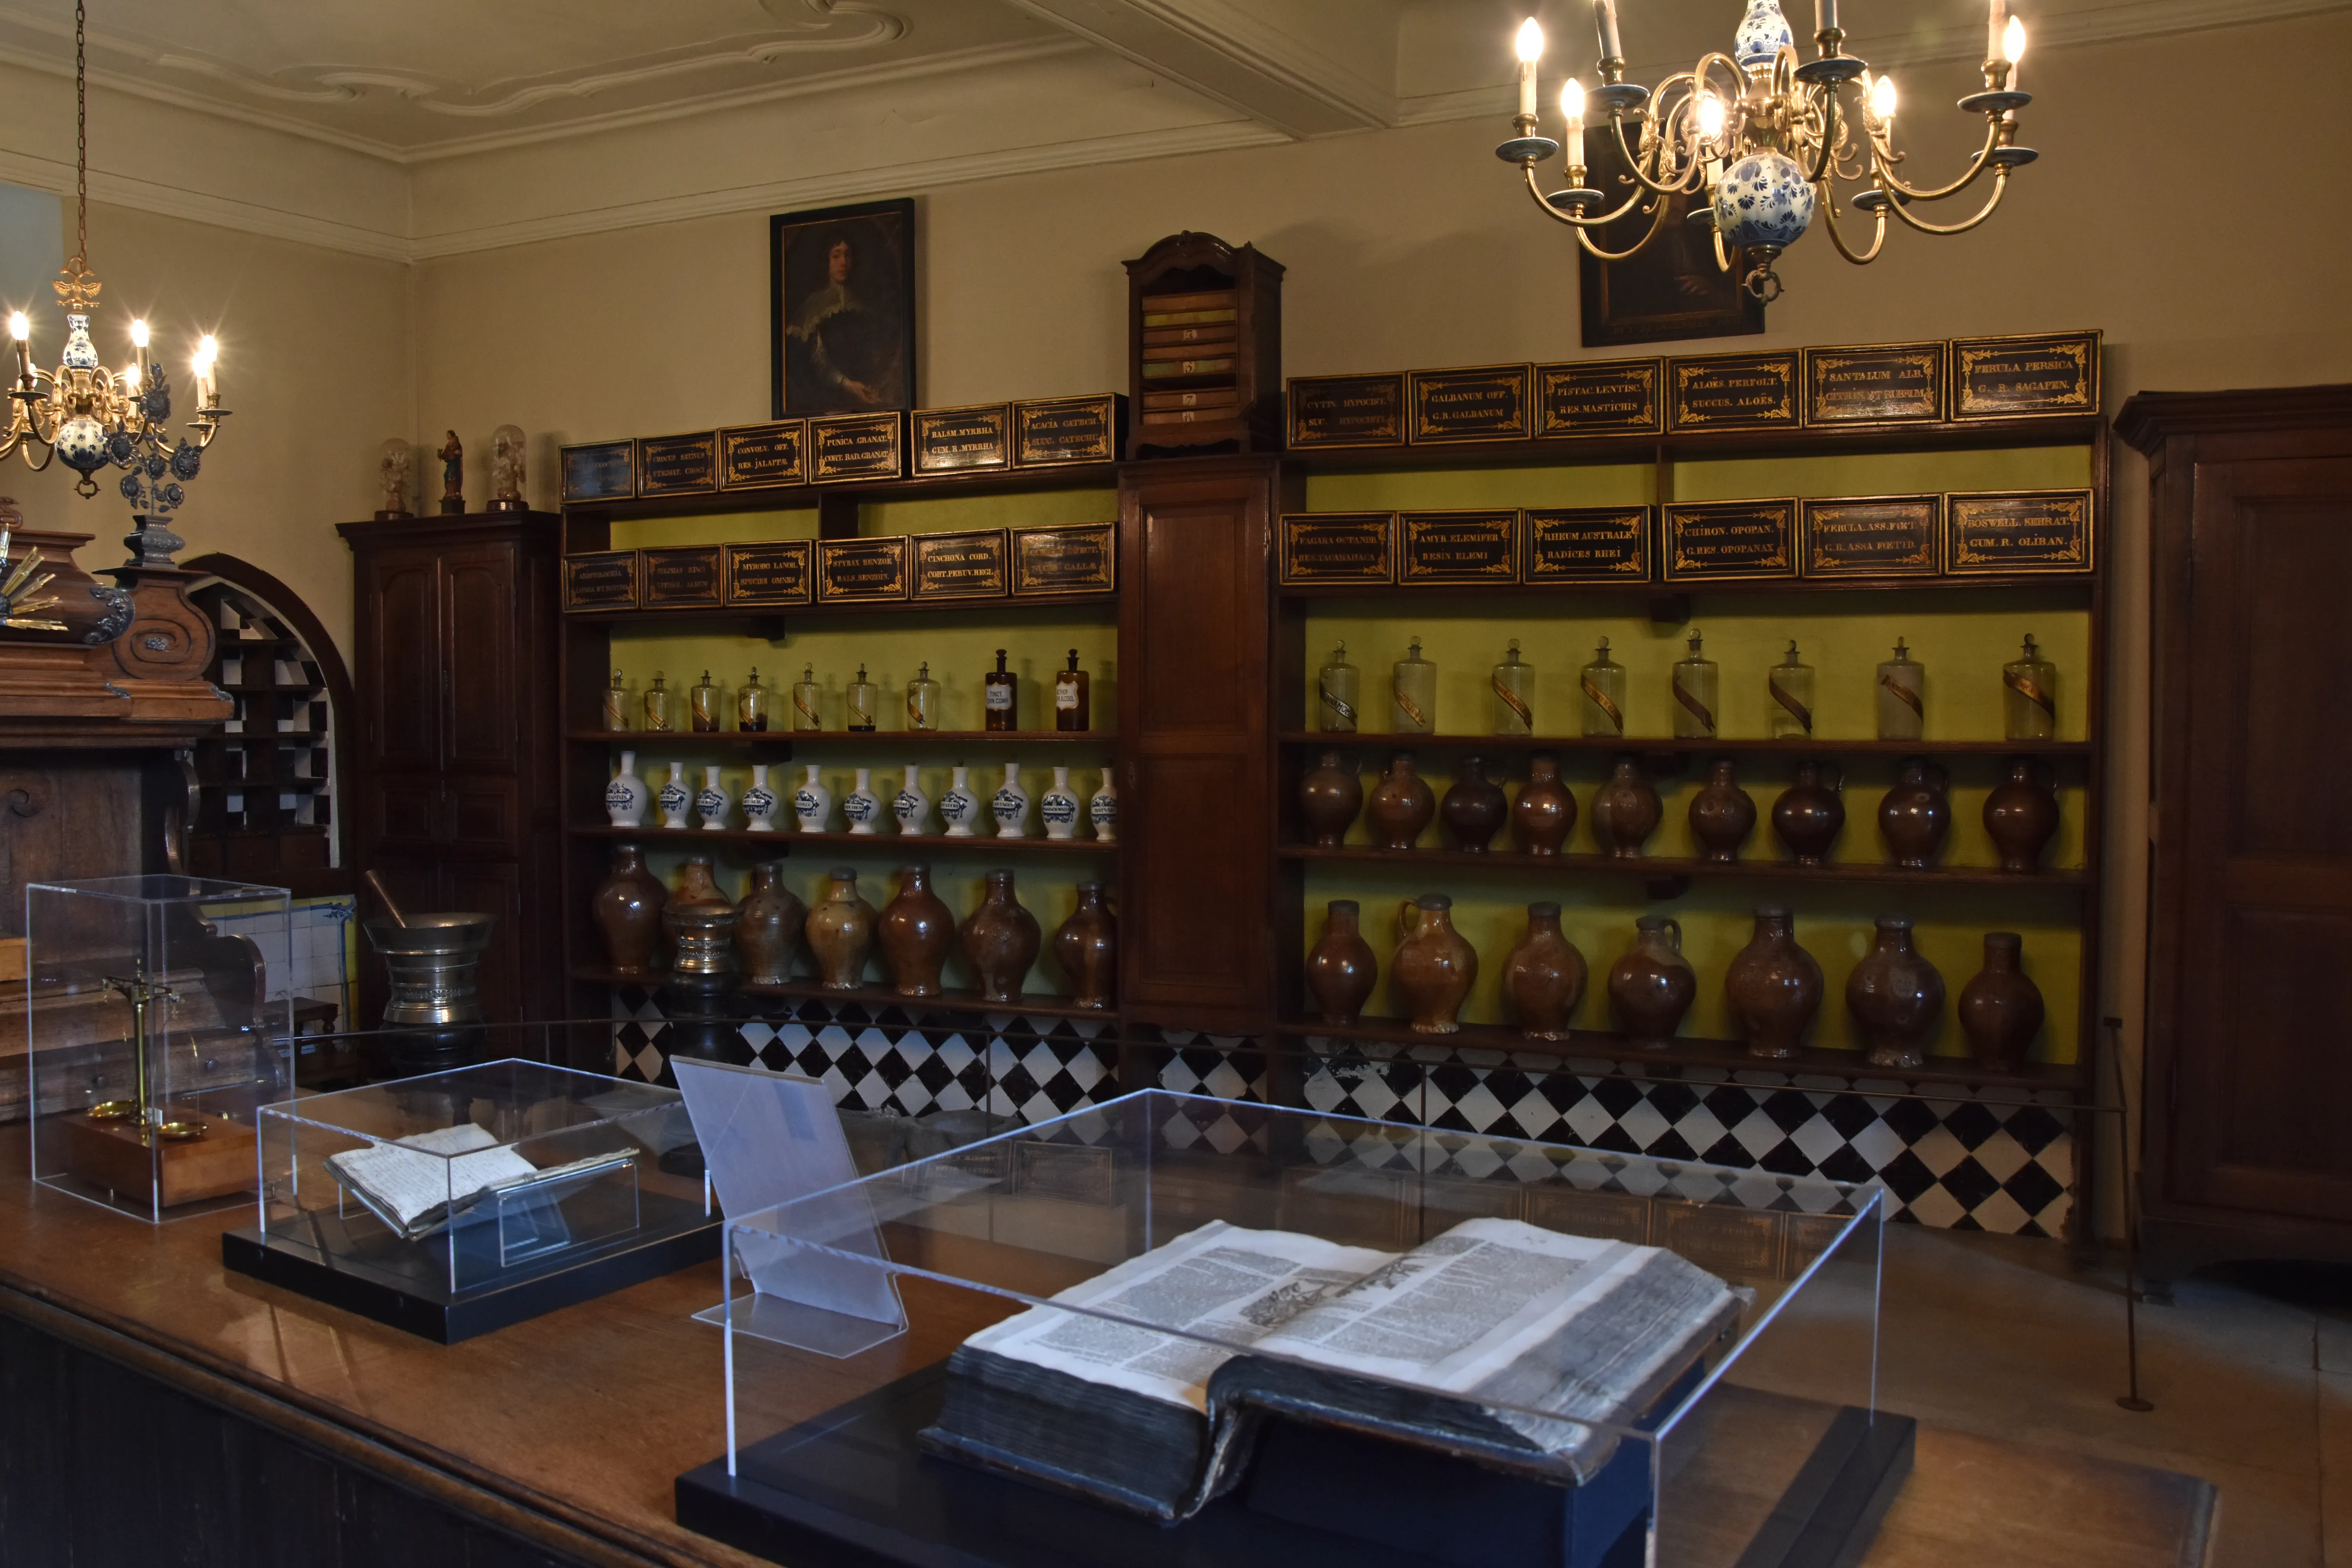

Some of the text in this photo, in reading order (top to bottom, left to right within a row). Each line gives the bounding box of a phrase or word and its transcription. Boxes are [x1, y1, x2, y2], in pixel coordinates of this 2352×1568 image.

[1974, 361, 2073, 373] FERULA PERSICA
[1829, 369, 1924, 381] SANTALUM ALB.
[1596, 384, 1641, 394] LENTISC.
[2016, 380, 2070, 391] SAGAPEN.
[1432, 392, 1483, 402] GALBANUM
[1692, 393, 1776, 408] SUCCUS. ALOËS.
[1559, 403, 1637, 414] RES. MASTICHIS
[1453, 409, 1504, 419] GALBANUM
[1031, 421, 1058, 430] ACACIA
[827, 437, 853, 446] PUNICA
[962, 443, 993, 452] MYRRHA
[653, 455, 676, 463] CROCUS
[1968, 517, 2070, 528] BOSWELL. SERRAT.
[1581, 531, 1632, 540] AUSTRALE
[1686, 525, 1774, 536] CHIRON. OPOPAN.
[1849, 543, 1872, 551] ASSA
[1969, 539, 1998, 547] GUM.
[2018, 537, 2068, 546] OLIBAN.
[1547, 549, 1622, 559] RADICES RHEI
[1721, 544, 1774, 554] OPOPANAX
